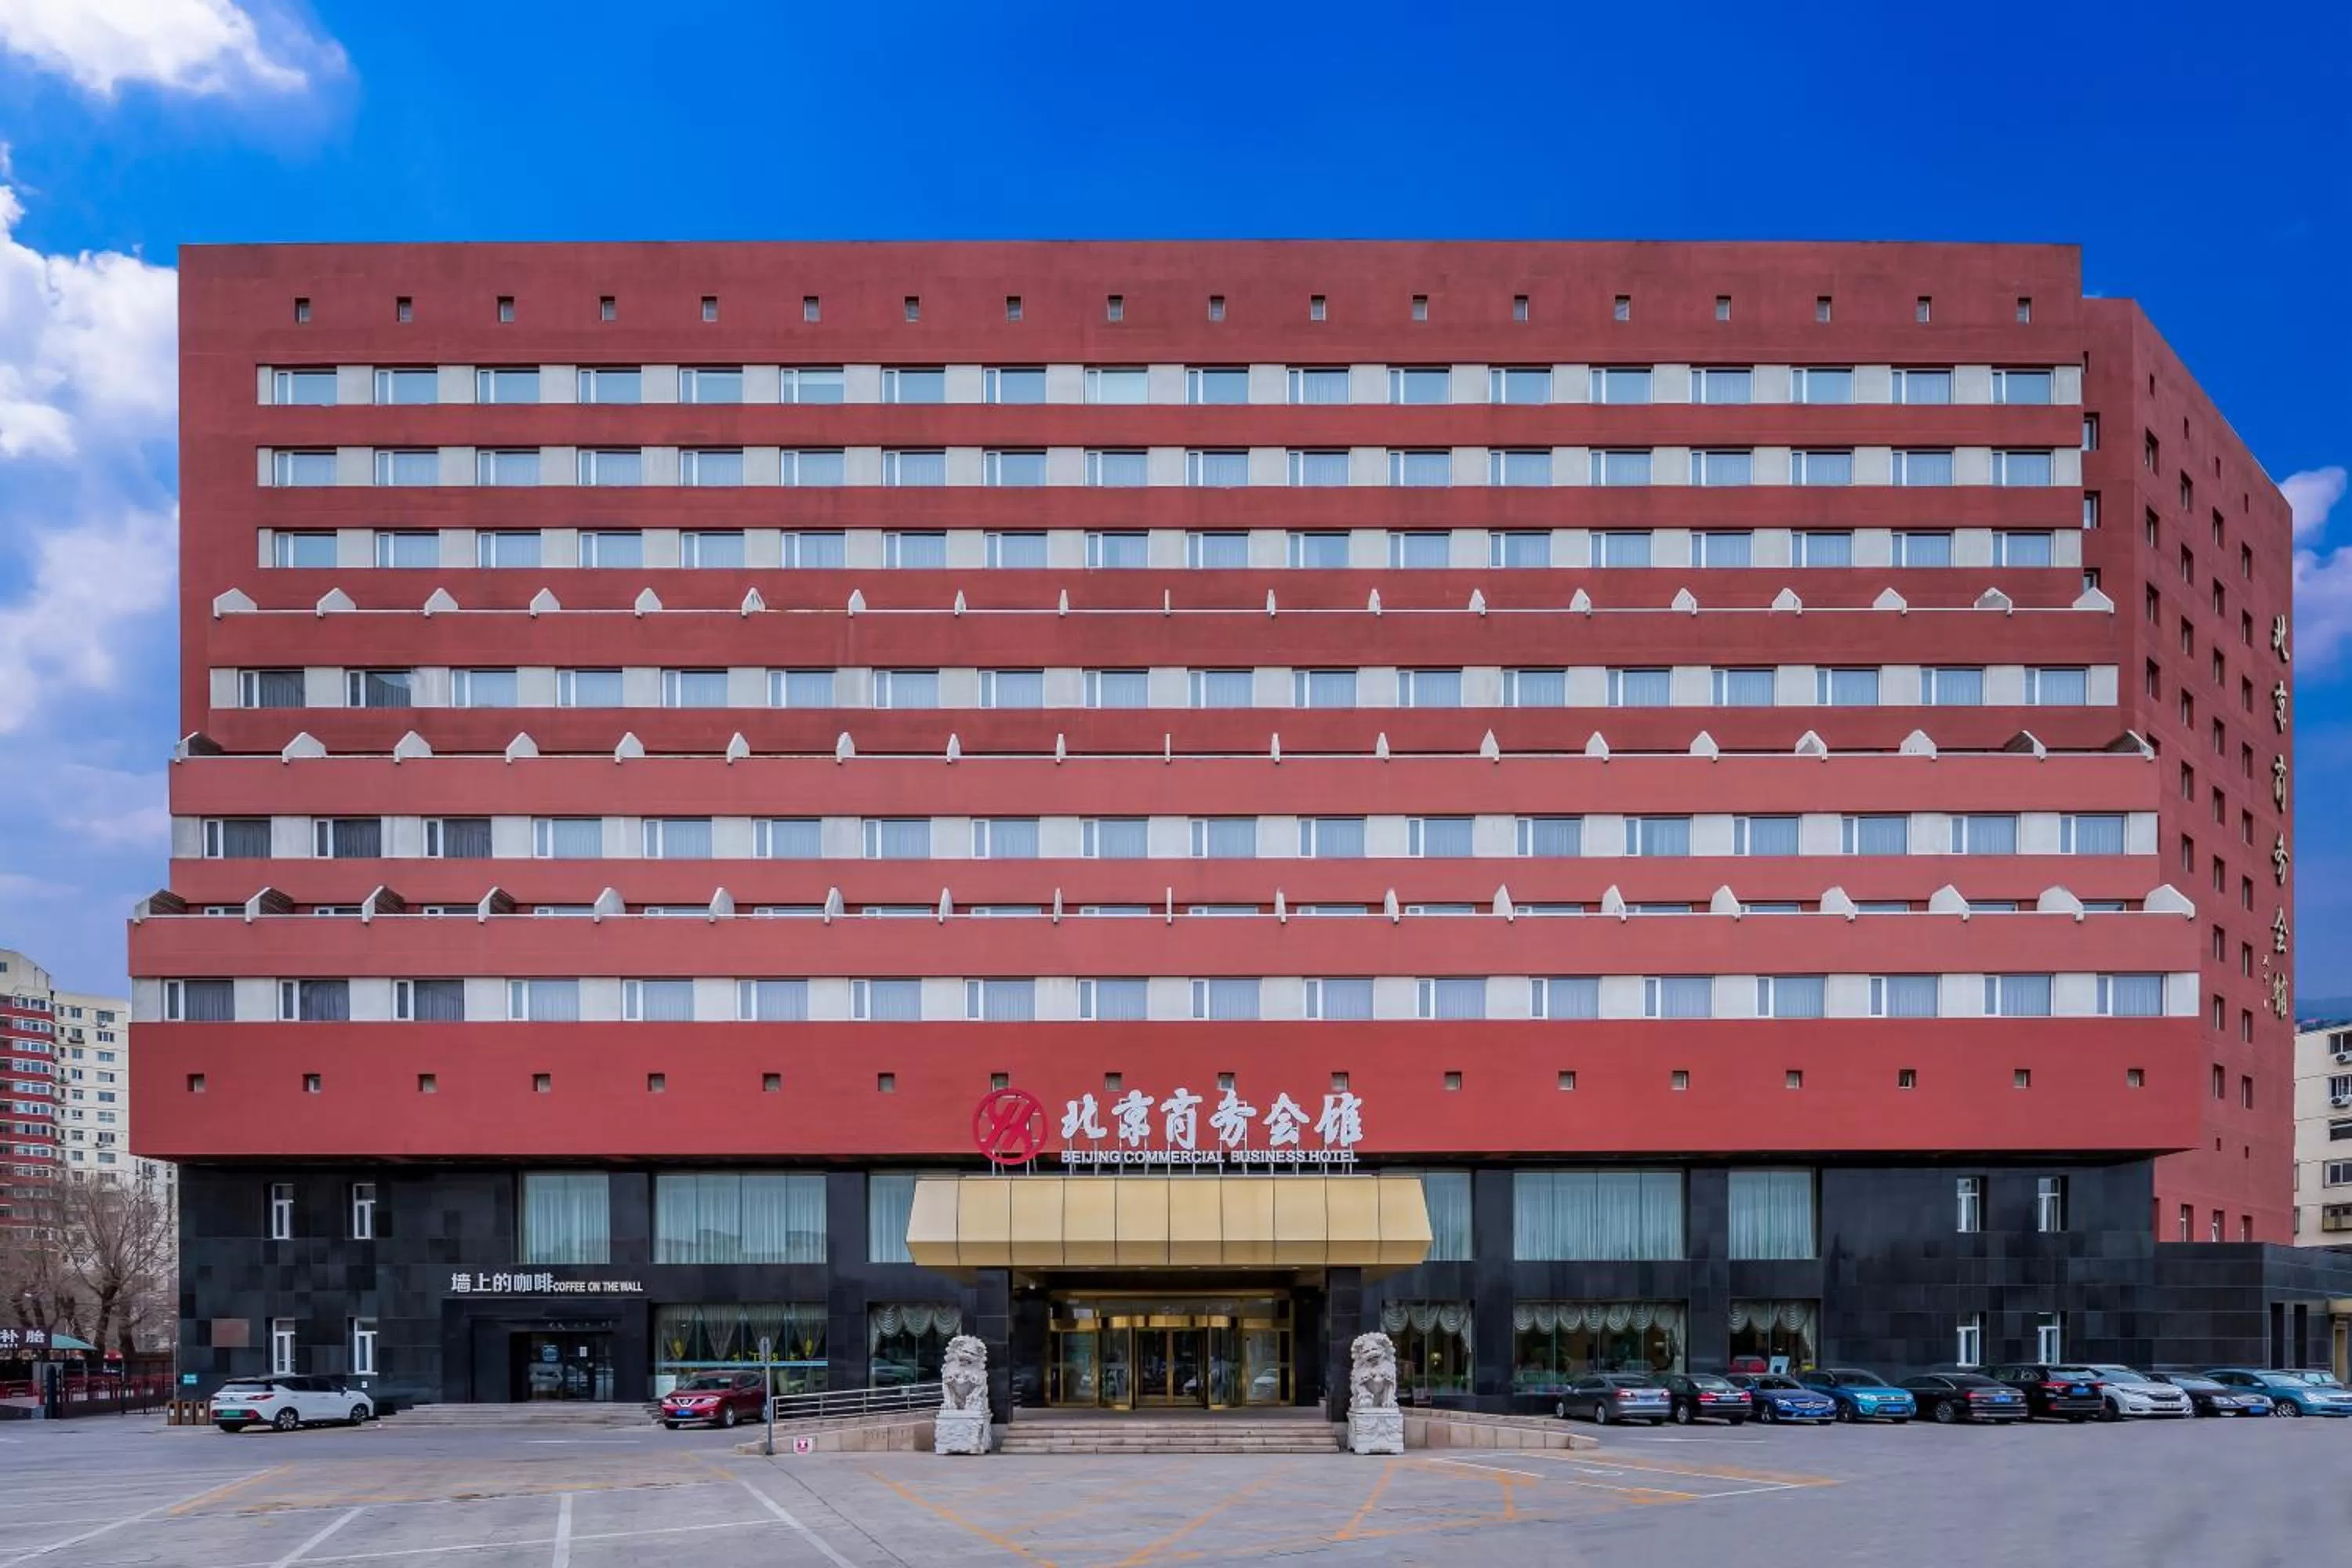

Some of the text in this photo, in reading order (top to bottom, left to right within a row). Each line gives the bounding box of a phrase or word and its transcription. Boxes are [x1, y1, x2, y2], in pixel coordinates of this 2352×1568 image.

[1061, 1087, 1363, 1149] 北京商务会馆
[1061, 1150, 1359, 1163] BEIJING COMMERCIAL BUSINESS HOTEL
[451, 1272, 554, 1292] 墙上的咖啡
[553, 1281, 644, 1292] COFFEE ON THE WALL
